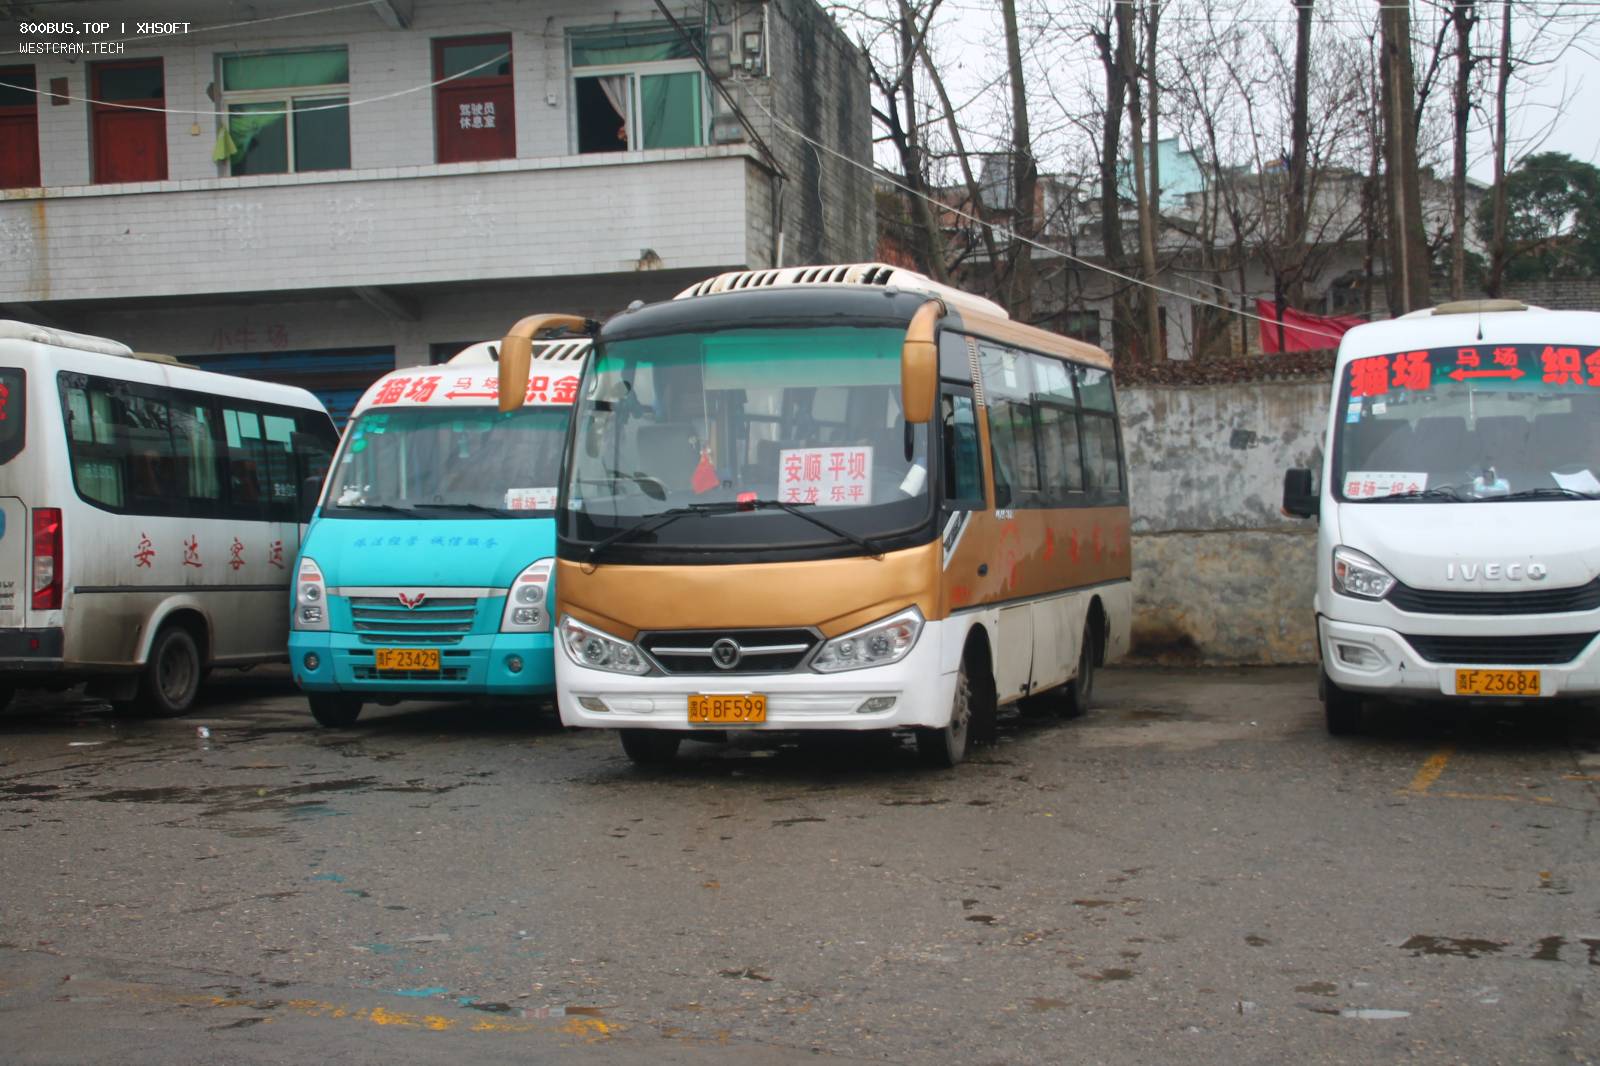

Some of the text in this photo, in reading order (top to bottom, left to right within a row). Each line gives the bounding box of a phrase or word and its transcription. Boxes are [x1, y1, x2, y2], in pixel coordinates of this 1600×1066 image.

[1350, 351, 1431, 397] 猫场
[1456, 347, 1518, 367] 马场
[372, 376, 442, 405] 猫场
[784, 452, 866, 482] 安顺 平坝
[786, 485, 865, 503] 天龙 乐平
[134, 532, 285, 570] 安达客运
[1446, 562, 1547, 581] IVECO
